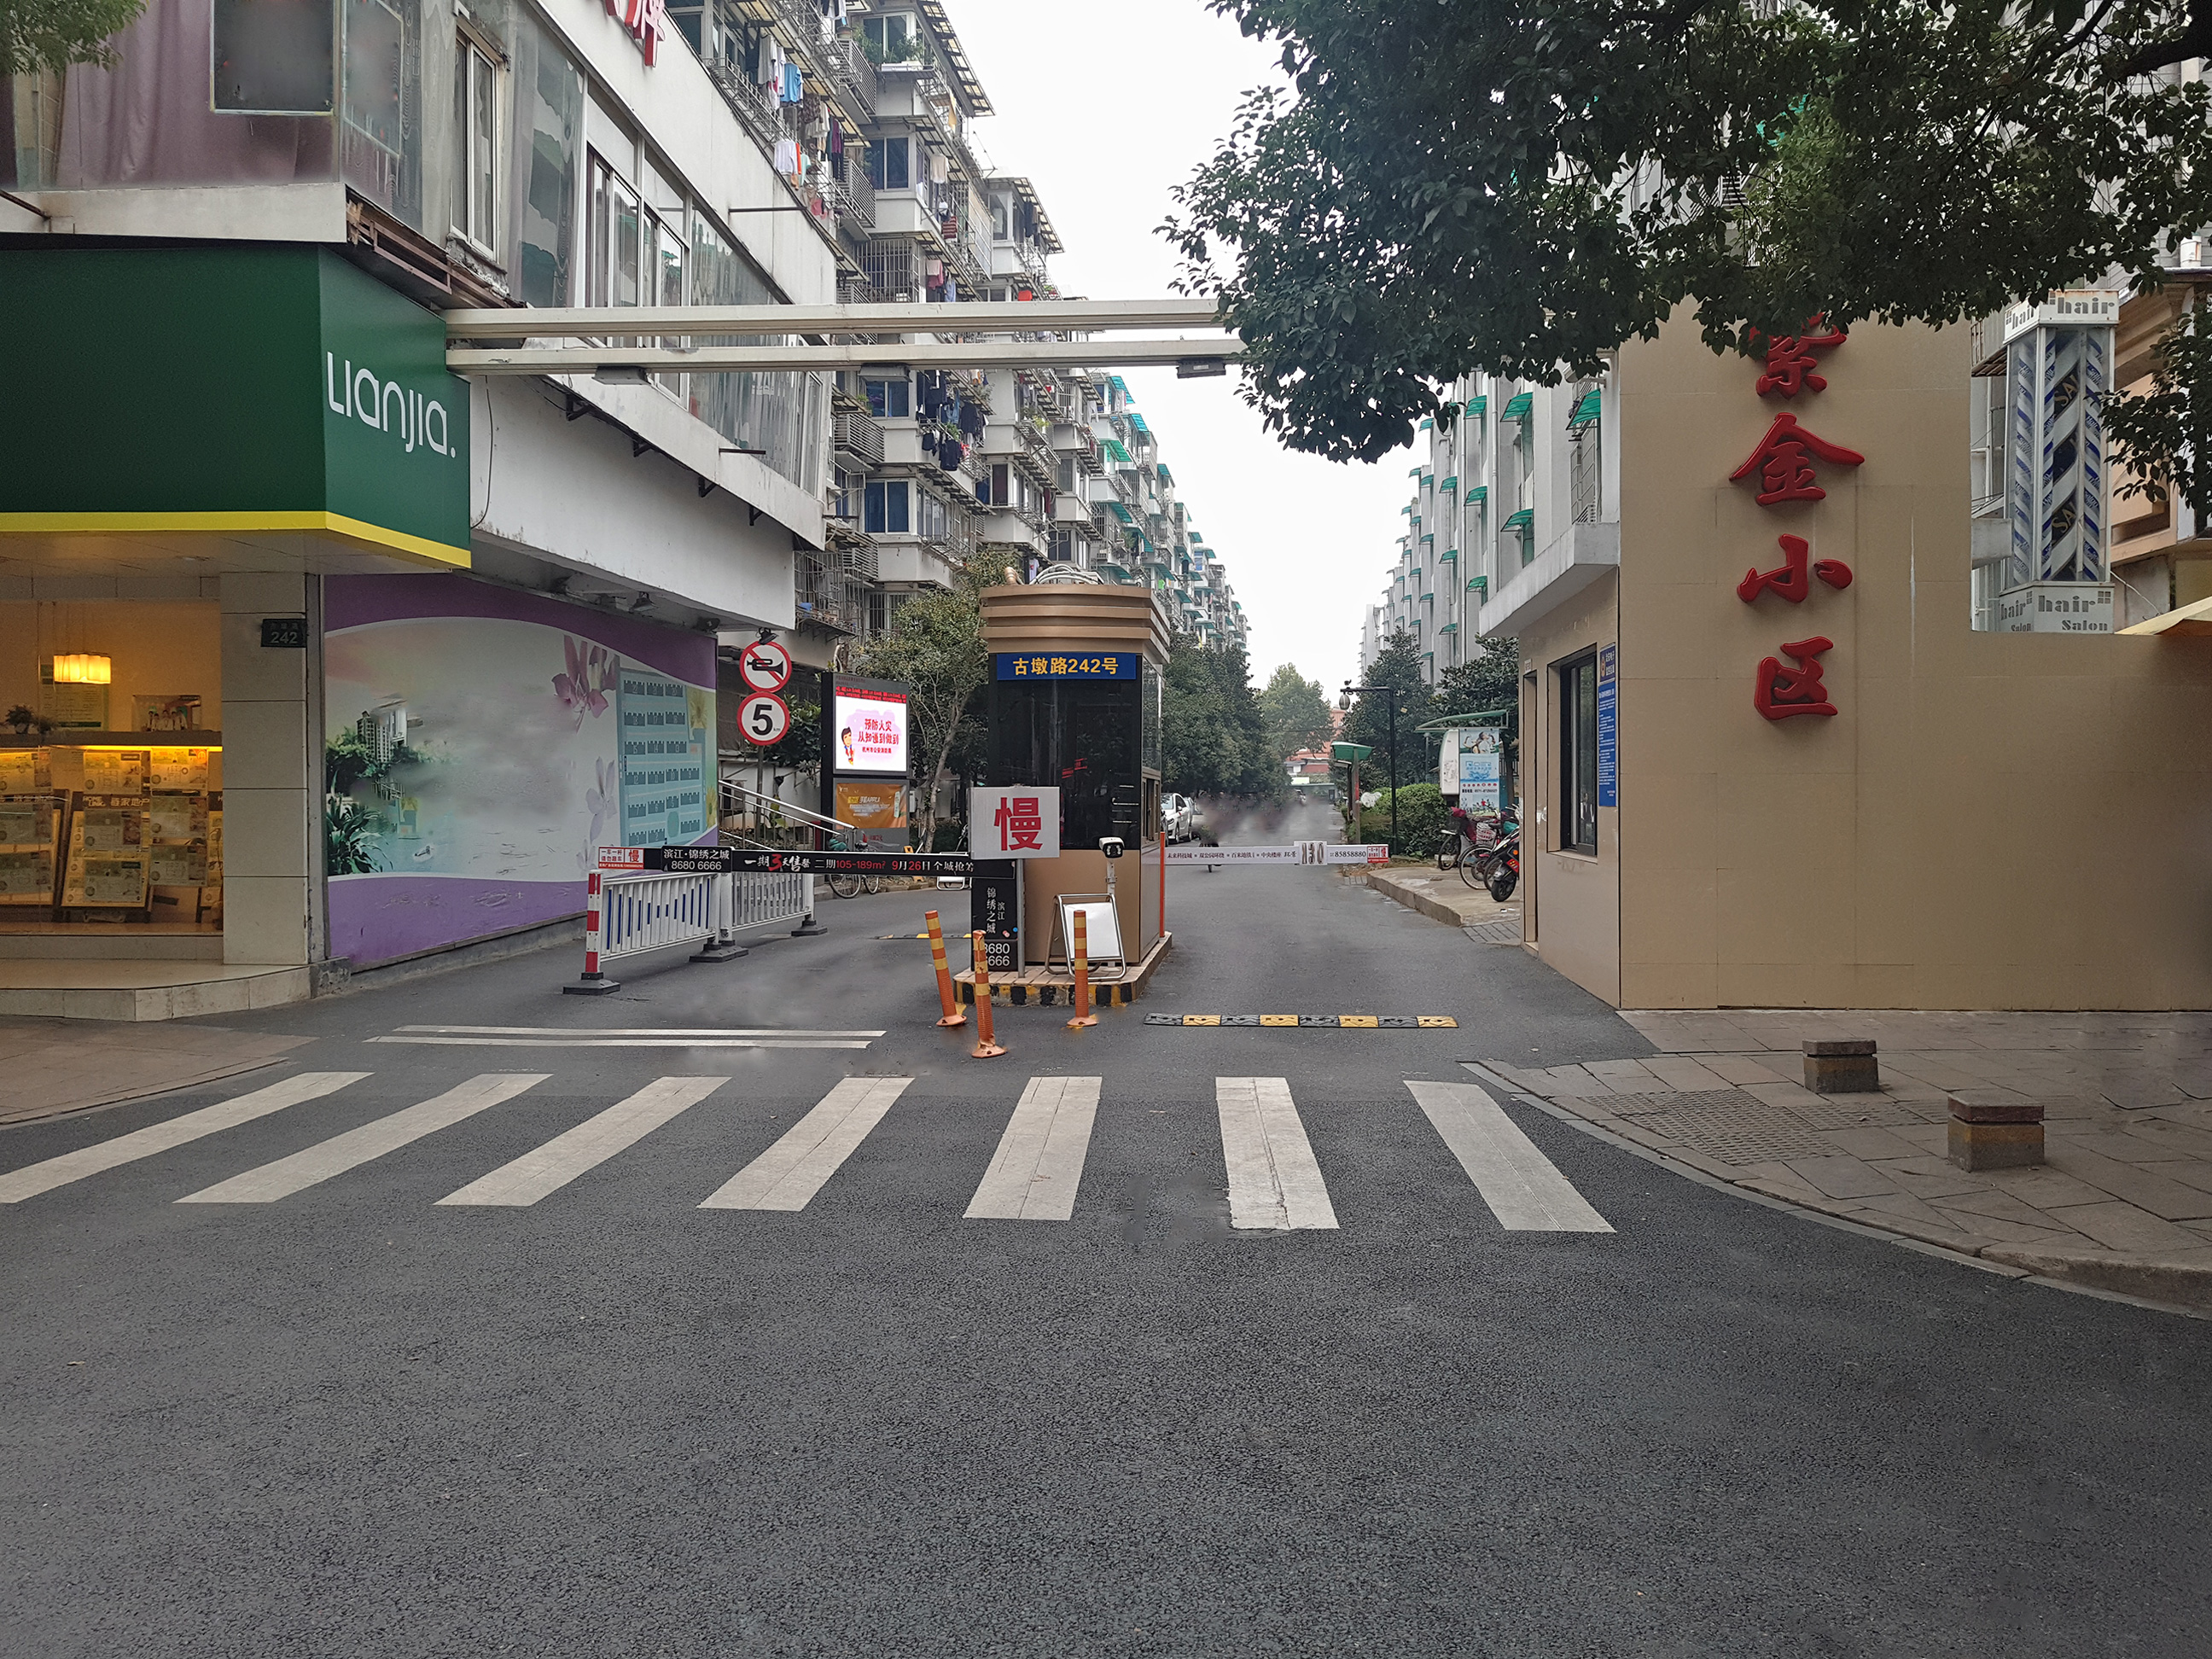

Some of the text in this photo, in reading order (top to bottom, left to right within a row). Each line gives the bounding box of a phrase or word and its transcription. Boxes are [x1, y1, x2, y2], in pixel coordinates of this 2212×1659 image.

[2058, 297, 2116, 314] hair
[2000, 600, 2026, 620] hair
[2038, 595, 2096, 613] hair
[2061, 620, 2108, 632] Salon
[270, 632, 298, 643] 242
[1013, 656, 1119, 675] 古墩路242号
[752, 703, 773, 736] 5
[864, 718, 892, 731] 预防火灾
[858, 731, 899, 745] 从知道到做到
[993, 796, 1043, 851] 慢
[628, 849, 640, 862] 慢
[671, 861, 722, 870] 8680 6666
[987, 887, 996, 934] 锦绣之城
[997, 901, 1005, 920] 滨江
[986, 955, 1010, 966] 666
